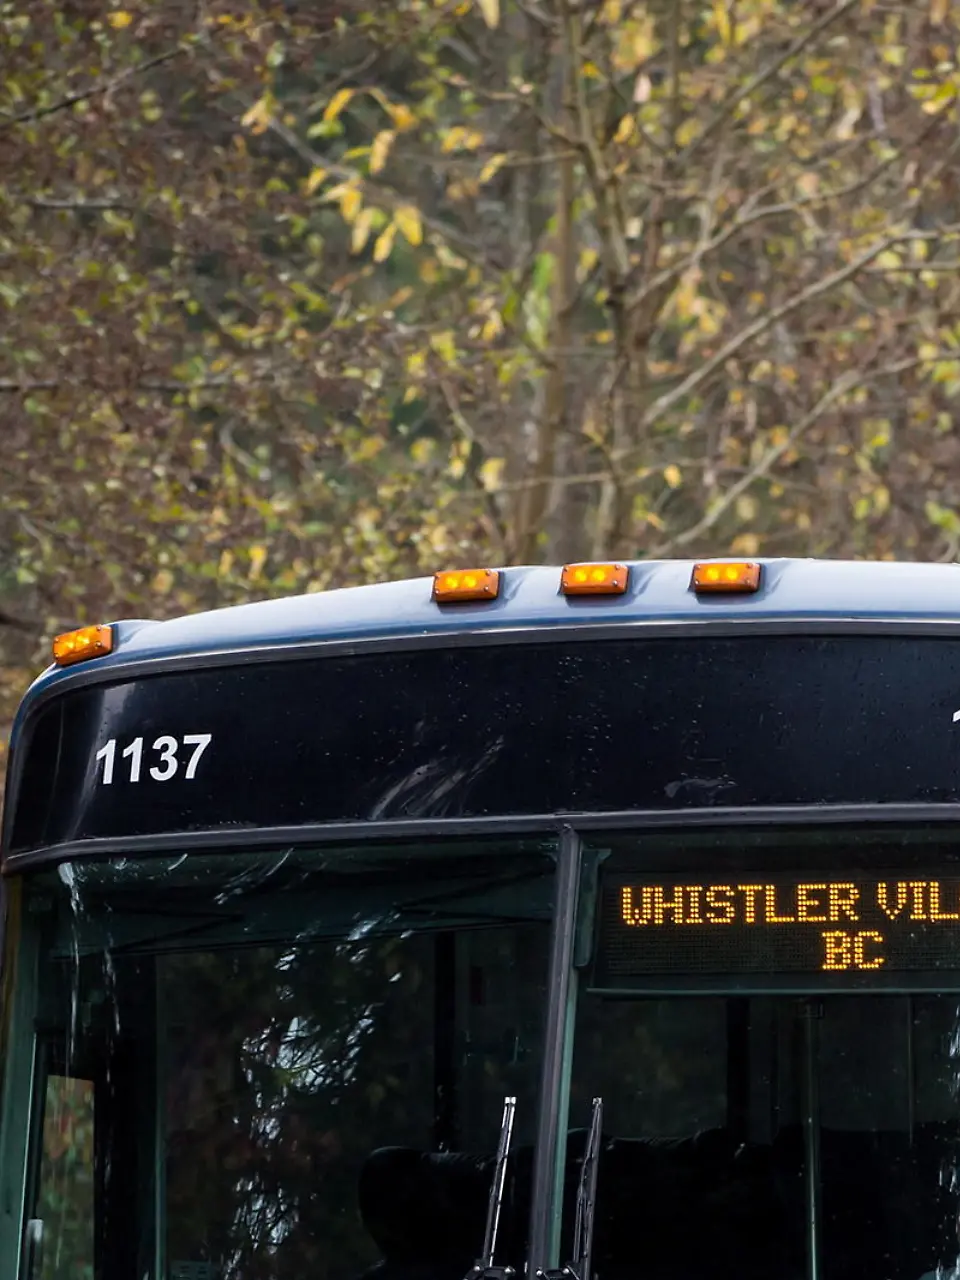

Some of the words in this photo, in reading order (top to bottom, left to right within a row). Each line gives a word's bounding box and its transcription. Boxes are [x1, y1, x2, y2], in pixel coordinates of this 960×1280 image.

[96, 733, 212, 785] 1137
[621, 882, 861, 925] WHISTLER
[822, 930, 885, 970] BC
